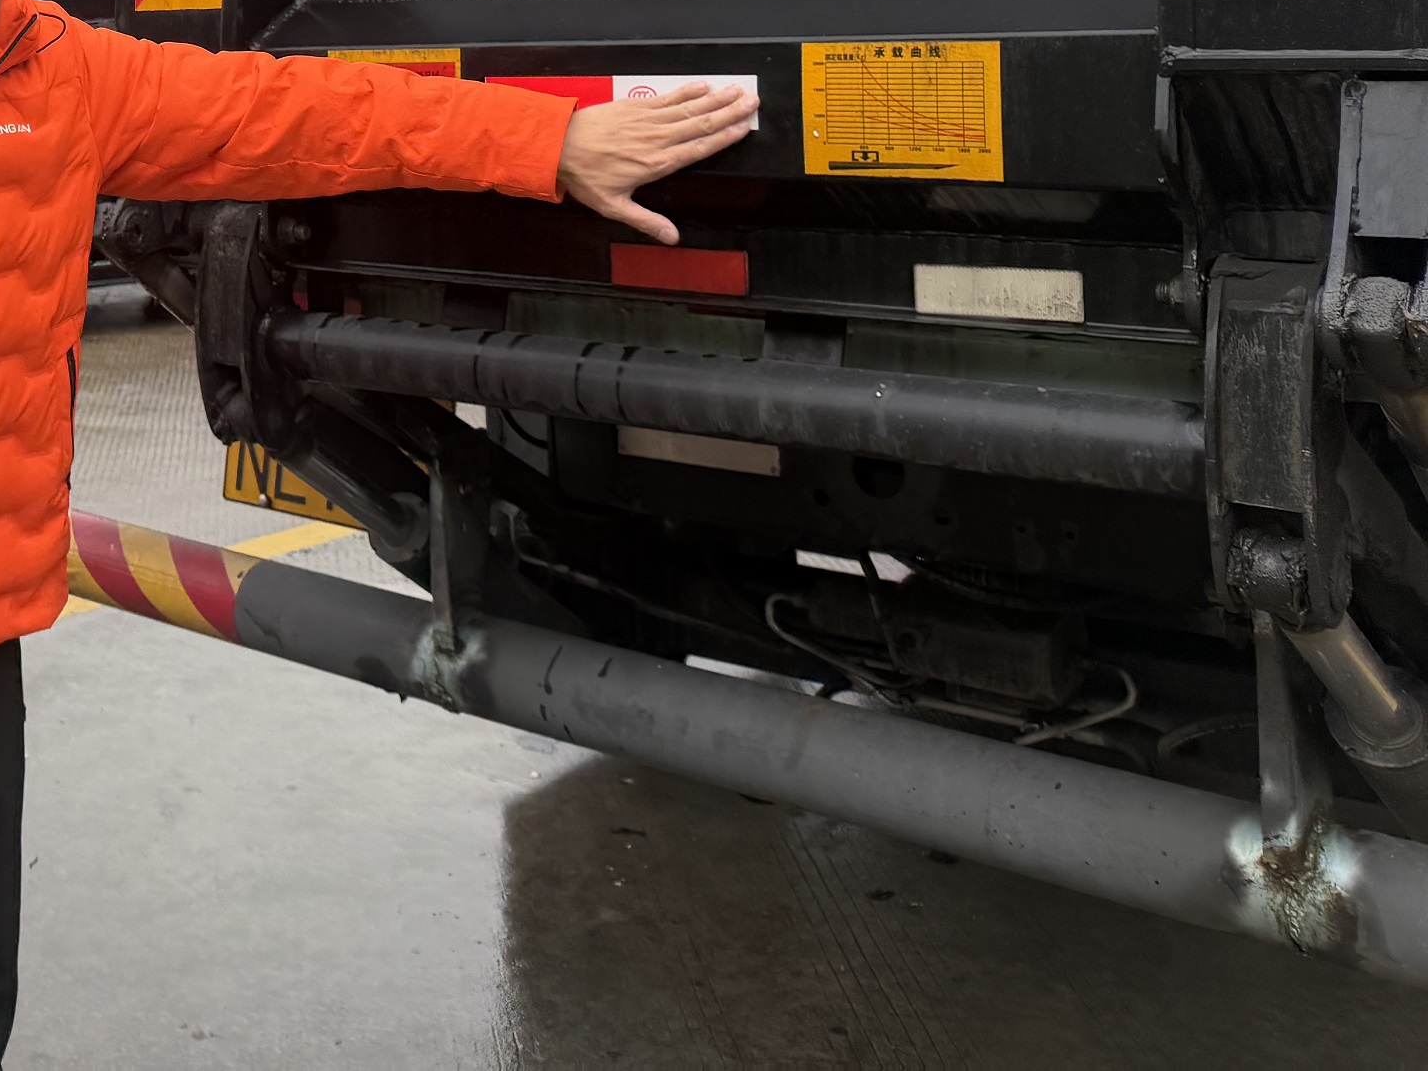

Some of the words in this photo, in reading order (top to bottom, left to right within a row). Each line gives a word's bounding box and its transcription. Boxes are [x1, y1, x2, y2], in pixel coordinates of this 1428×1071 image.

[873, 46, 941, 59] 承载曲线
[235, 440, 335, 511] NL
